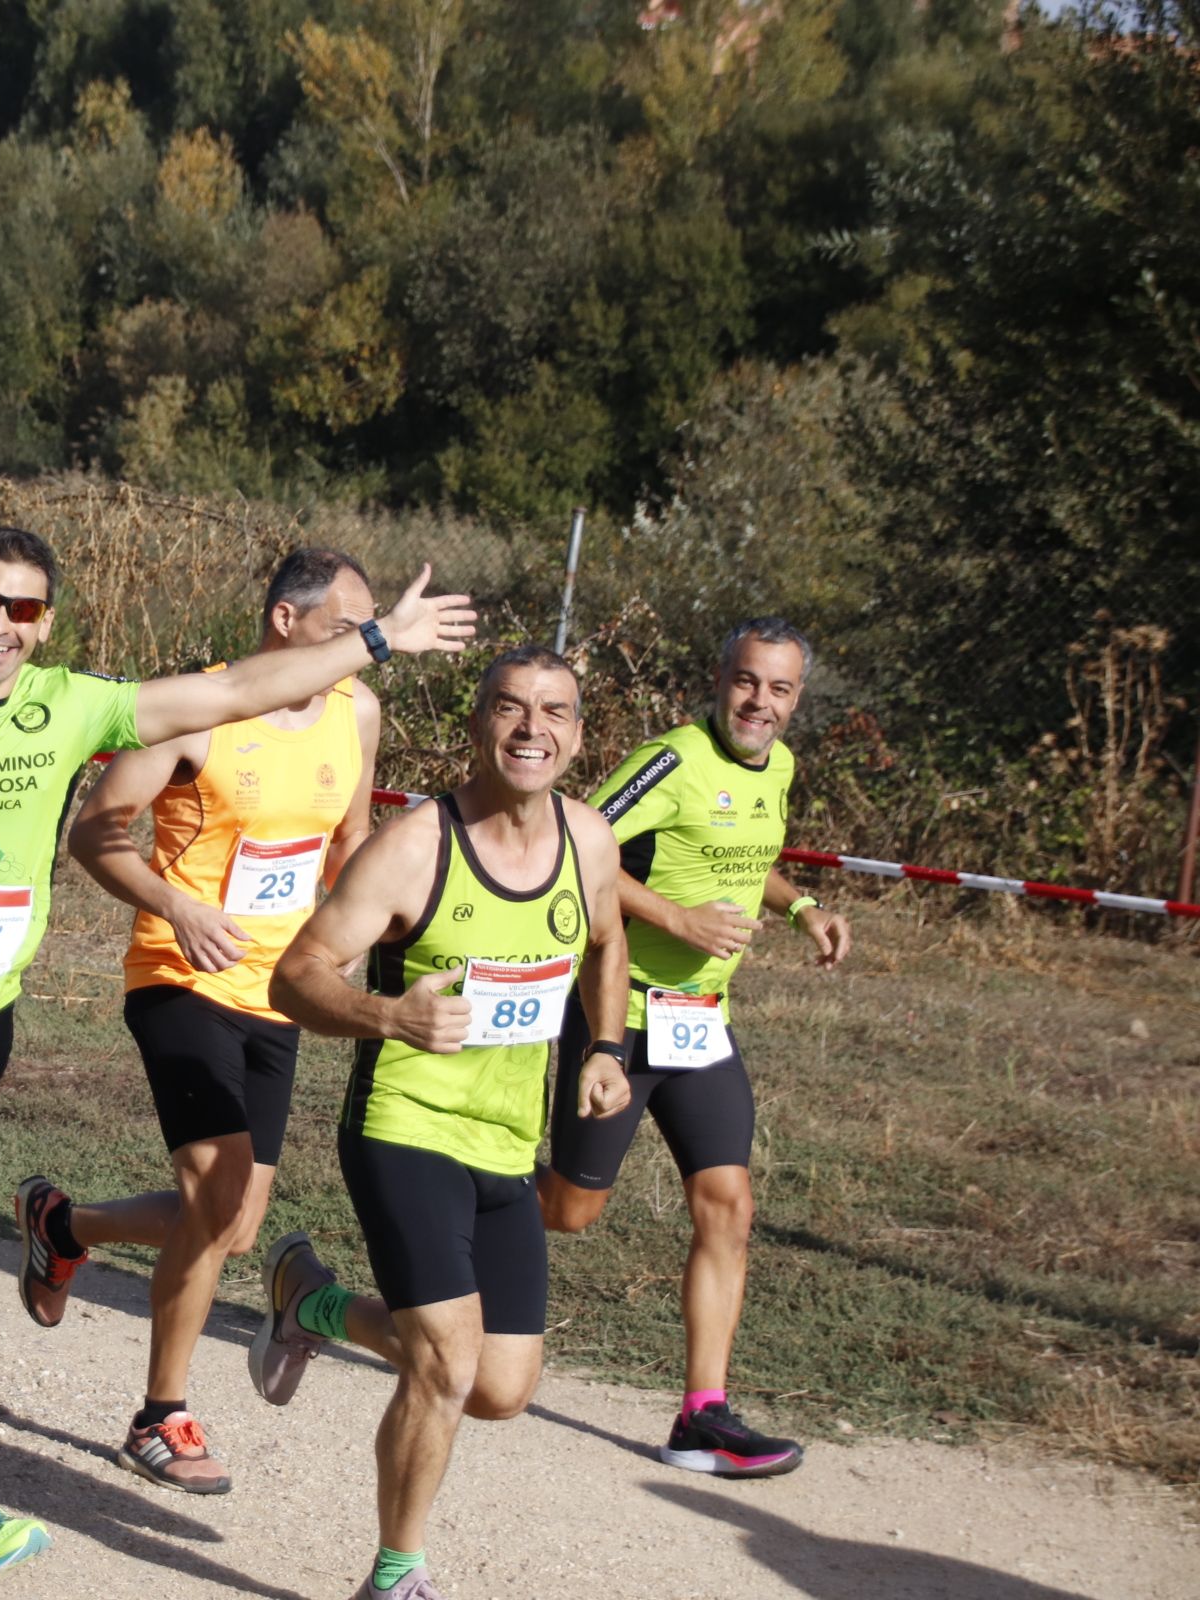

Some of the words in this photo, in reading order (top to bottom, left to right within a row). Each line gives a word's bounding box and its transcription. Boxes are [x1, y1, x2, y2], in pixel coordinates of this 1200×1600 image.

[601, 751, 676, 820] CORRECAMINOS
[255, 870, 297, 900] 23
[491, 998, 541, 1028] 89
[672, 1022, 708, 1050] 92
